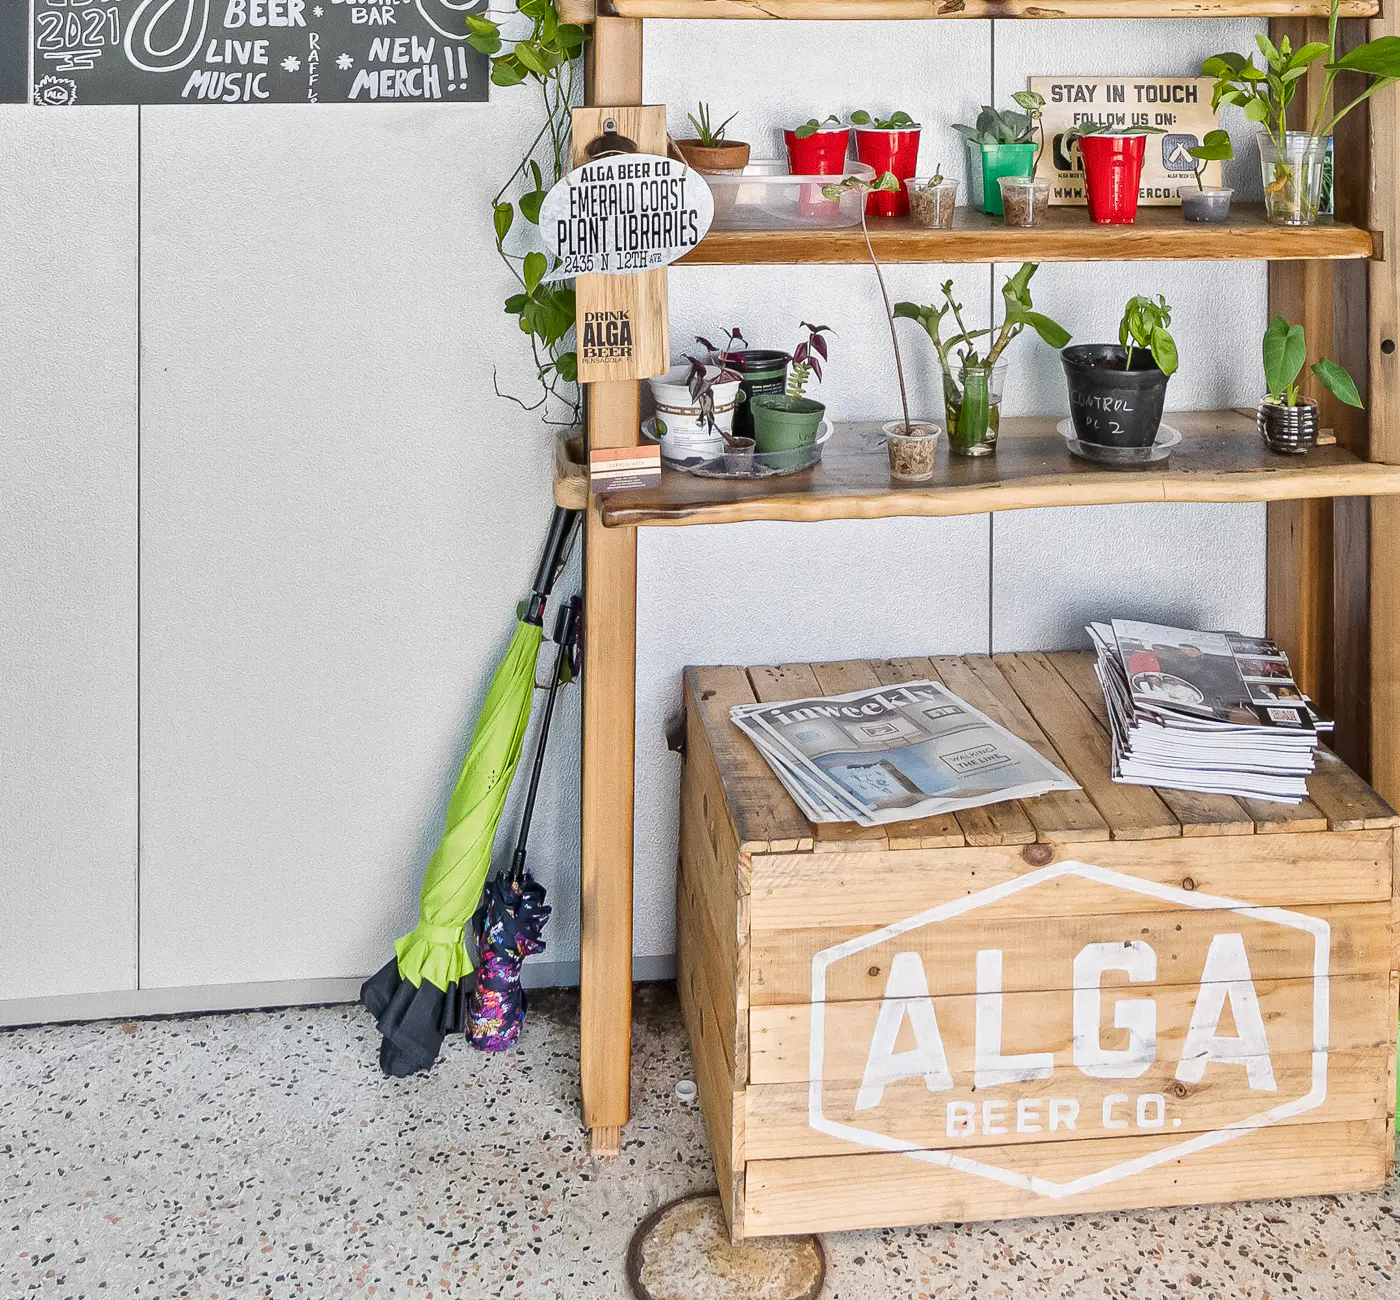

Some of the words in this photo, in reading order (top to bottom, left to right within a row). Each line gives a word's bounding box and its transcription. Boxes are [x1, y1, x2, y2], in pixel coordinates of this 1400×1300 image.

[351, 6, 397, 26] BAR
[36, 7, 122, 51] 2021
[205, 38, 271, 67] LIVE
[367, 37, 437, 63] NEW
[181, 70, 271, 101] MUSIC
[1051, 84, 1098, 103] STAY
[1106, 84, 1126, 103] IN
[1133, 84, 1199, 104] TOUCH
[1073, 112, 1126, 126] FOLLOW
[1131, 112, 1150, 126] US
[1154, 112, 1178, 126] ON:
[580, 165, 615, 183] ALGA
[617, 162, 651, 180] BEER
[654, 160, 671, 177] CO
[569, 182, 635, 219] EMERALD
[640, 177, 687, 213] COAST
[557, 215, 609, 256] PLANT
[614, 208, 699, 252] LIBRARIES
[564, 254, 594, 274] 2435
[600, 252, 610, 271] N
[616, 250, 648, 270] 12TH
[648, 252, 662, 264] AVE
[584, 310, 630, 322] DRINK
[582, 320, 633, 347] ALGA
[583, 347, 633, 358] BEER
[1070, 389, 1134, 412] CONTROL
[1108, 421, 1125, 434] 2
[773, 687, 937, 727] inweekly
[956, 759, 979, 769] THE
[977, 753, 1002, 764] LINE
[854, 932, 1278, 1112] ALGA
[945, 1096, 1080, 1139] BEER
[1102, 1093, 1184, 1130] CO.
